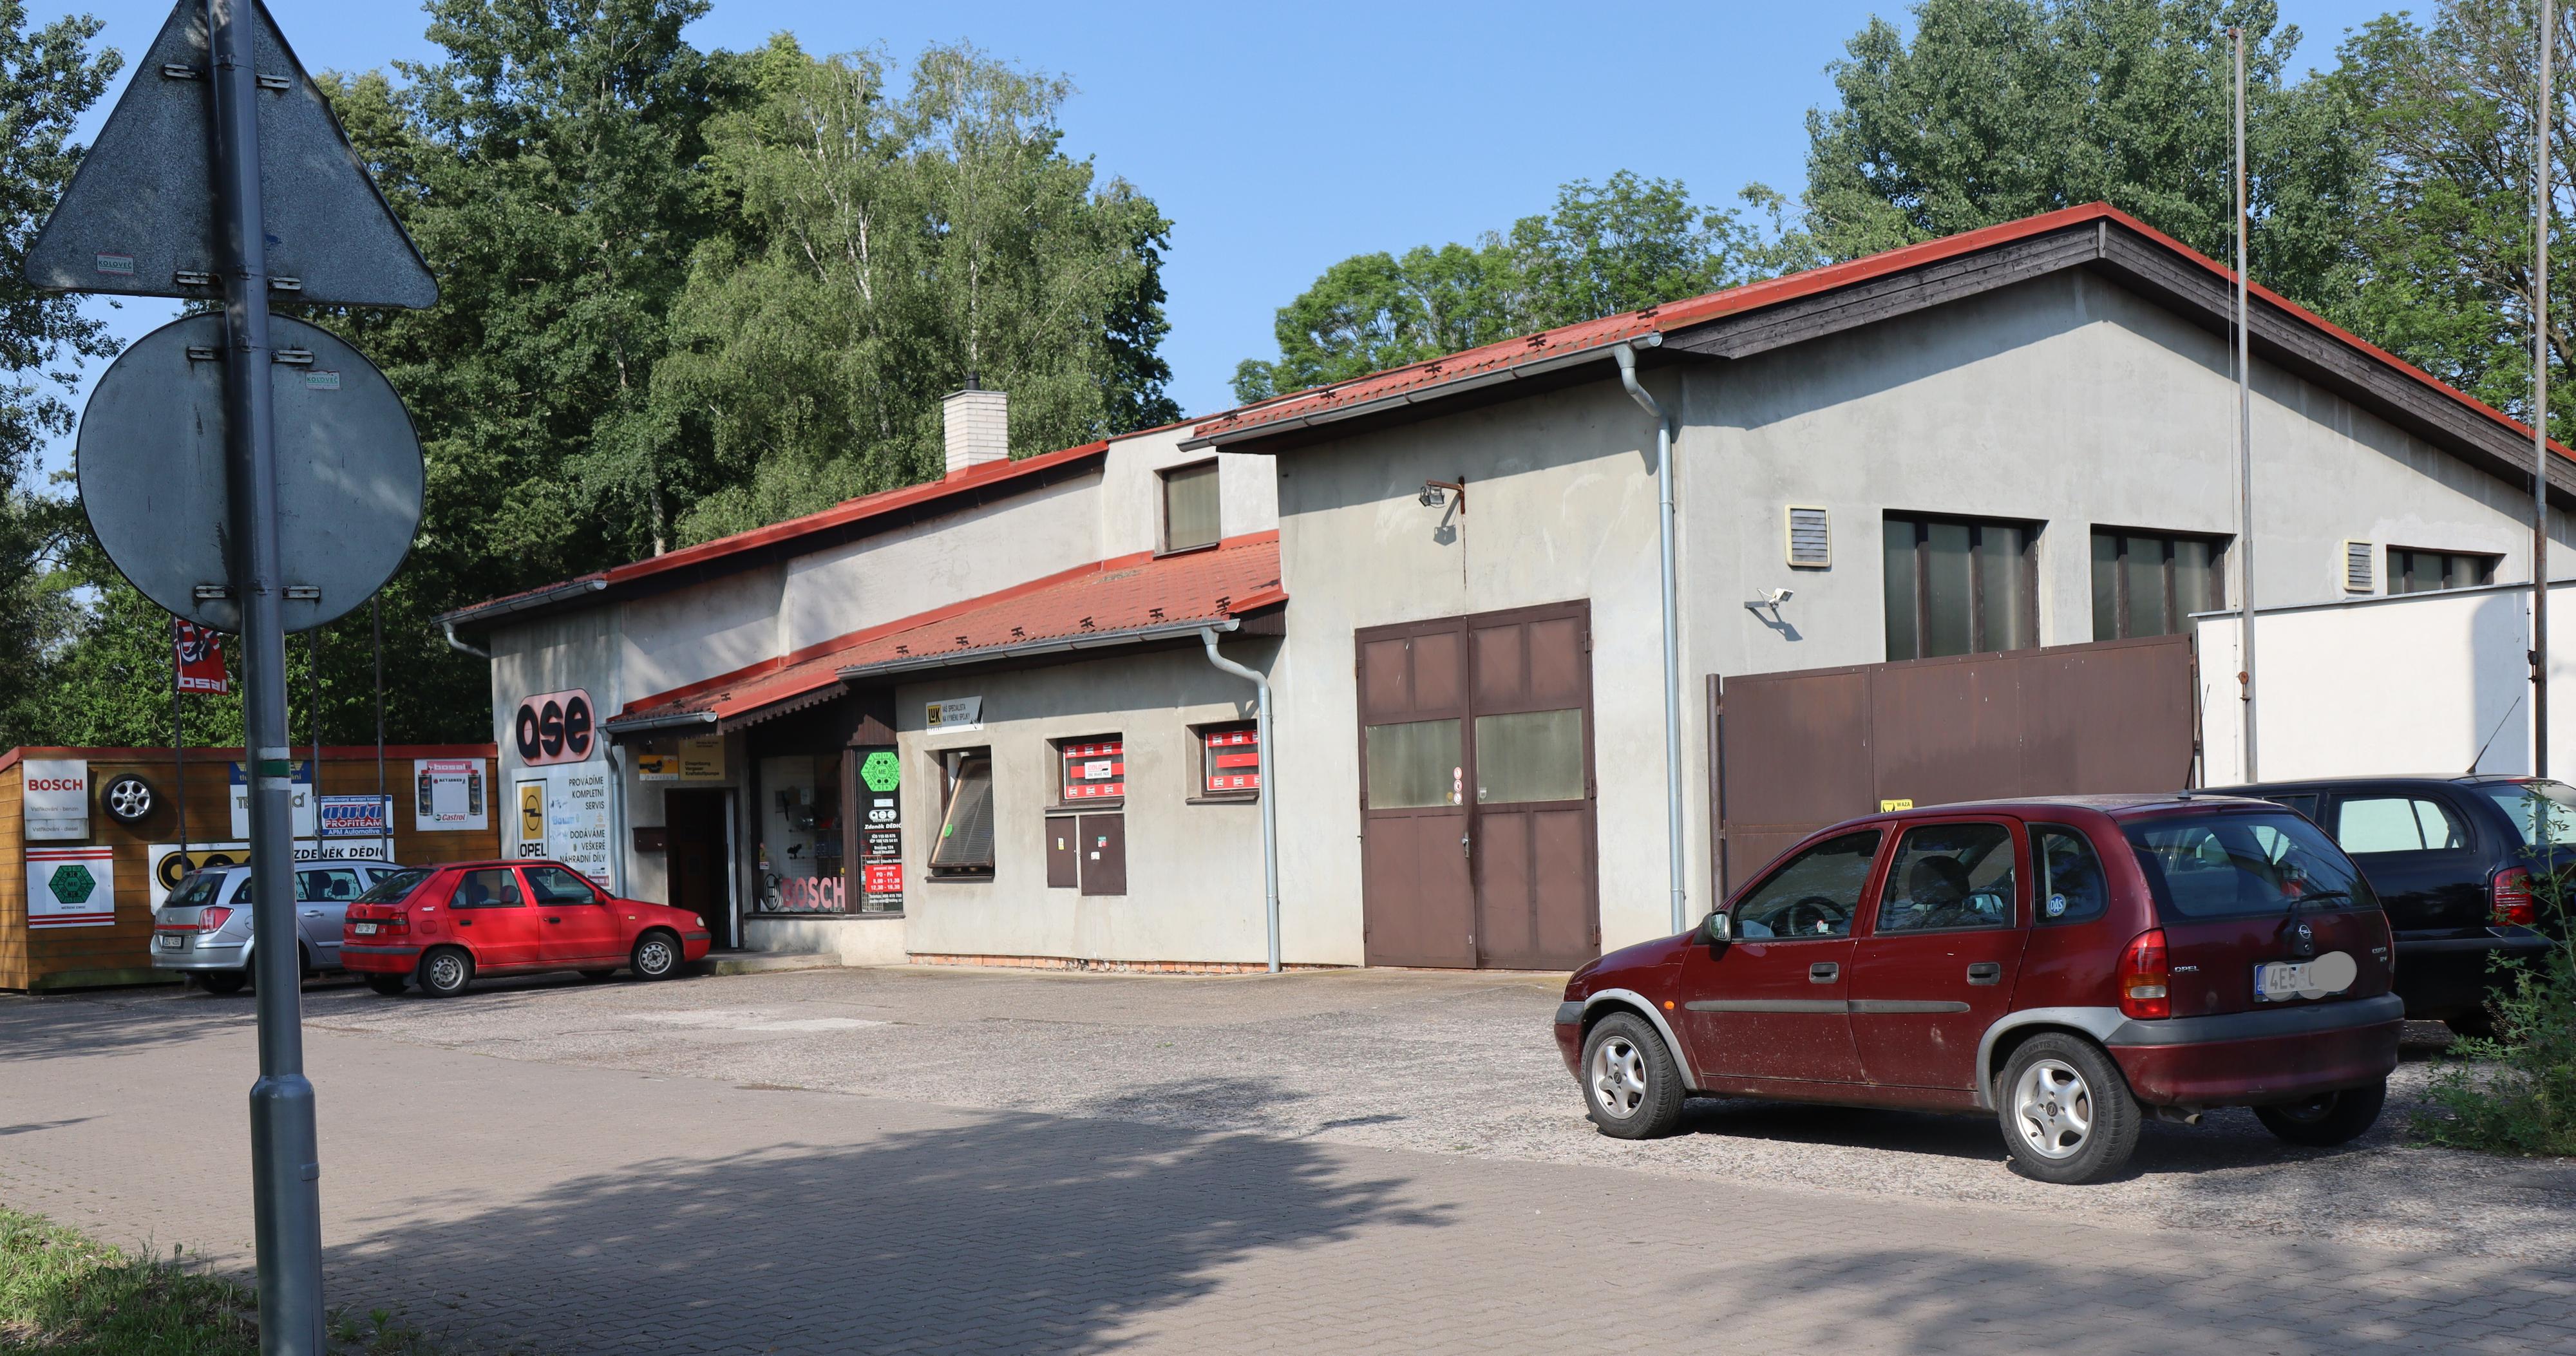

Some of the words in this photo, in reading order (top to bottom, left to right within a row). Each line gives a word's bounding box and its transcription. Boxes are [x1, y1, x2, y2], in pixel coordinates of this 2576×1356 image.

[516, 696, 591, 759] ase
[28, 778, 83, 791] BOSCH
[569, 774, 603, 787] PROVÁDÍME
[572, 786, 604, 799] KOMPLETNÍ
[585, 801, 605, 810] SERVIS
[326, 819, 382, 828] PROFITEAM
[570, 827, 605, 839] DODÁVÁME
[520, 842, 547, 858] OPEL
[582, 840, 606, 851] VEŠKERÉ
[294, 846, 345, 859] ZDENĚK
[560, 852, 591, 863] NÁHRADNÍ
[593, 852, 606, 863] DÍLY
[782, 876, 846, 909] BOSCH
[2050, 898, 2063, 912] DAS
